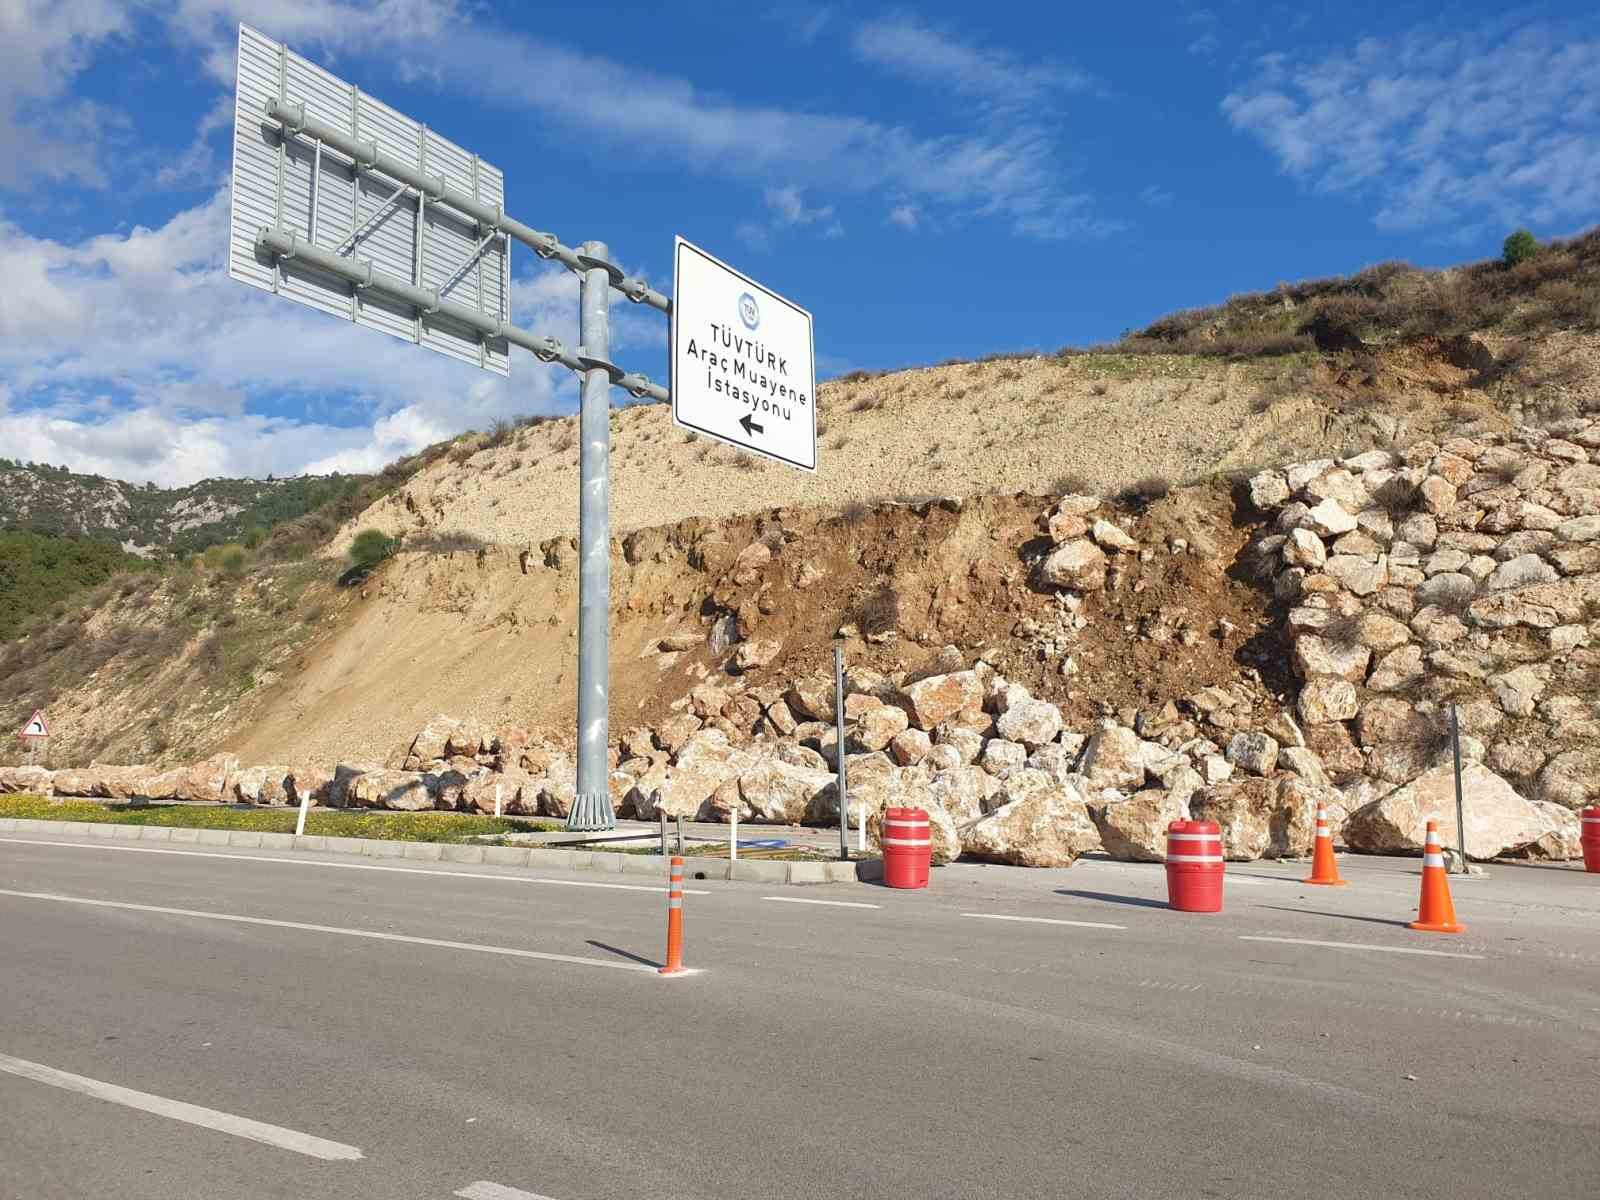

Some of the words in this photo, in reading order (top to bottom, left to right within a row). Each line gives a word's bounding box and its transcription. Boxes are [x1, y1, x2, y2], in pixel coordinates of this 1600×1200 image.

[687, 339, 728, 373] Araç
[734, 359, 807, 406] Muayene
[710, 323, 788, 375] TÜVTÜRK
[707, 365, 791, 421] İstasyonu
